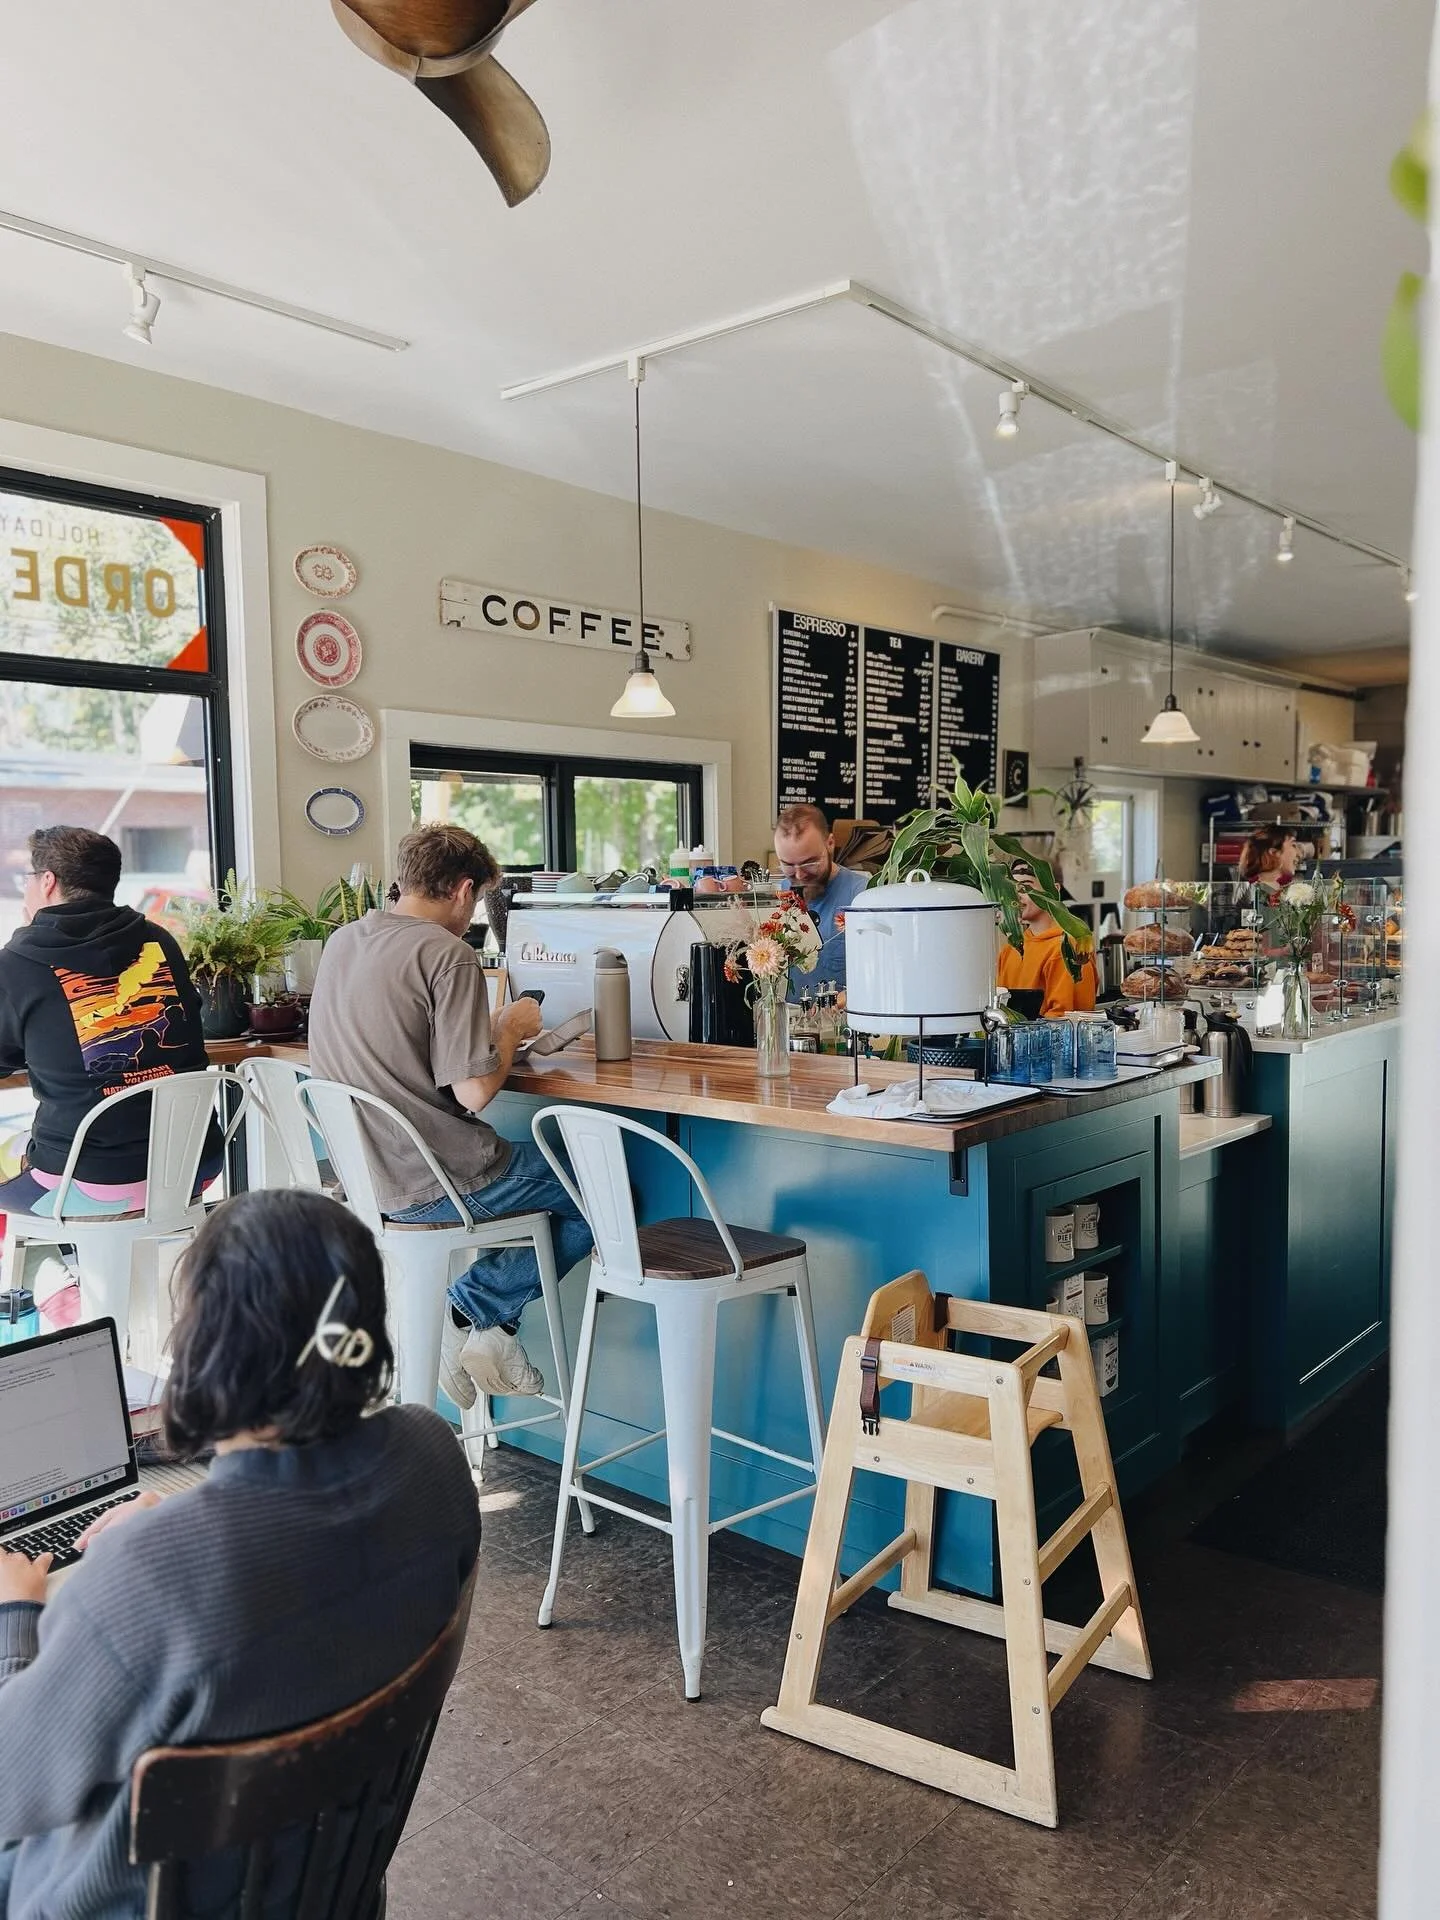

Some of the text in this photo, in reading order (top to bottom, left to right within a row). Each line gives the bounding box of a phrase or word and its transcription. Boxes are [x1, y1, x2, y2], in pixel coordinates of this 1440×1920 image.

[482, 595, 660, 650] COFFEE
[793, 613, 847, 638] ESPRESSO
[889, 636, 902, 649] TEA
[956, 648, 986, 666] BAKERY
[809, 750, 826, 759] COFFEE
[1057, 1233, 1069, 1242] PIE
